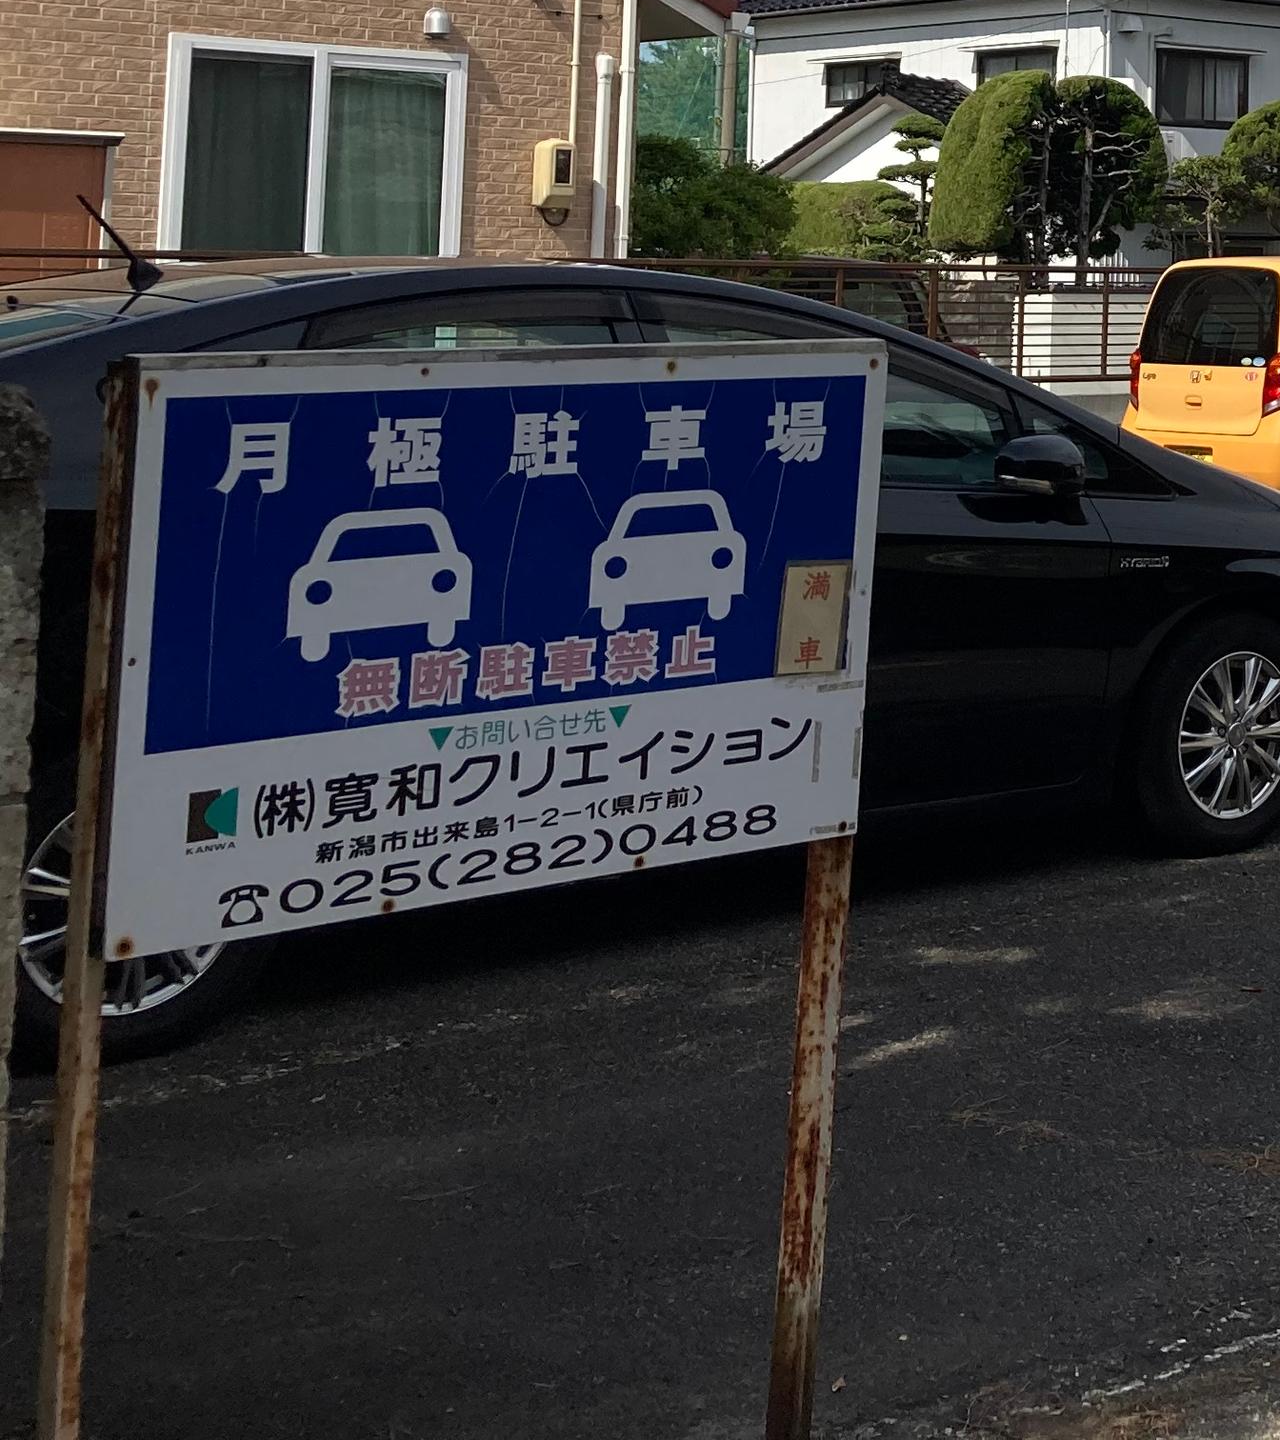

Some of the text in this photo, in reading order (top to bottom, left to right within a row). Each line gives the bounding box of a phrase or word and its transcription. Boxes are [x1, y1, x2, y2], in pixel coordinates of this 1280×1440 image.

[214, 400, 829, 495] 月極駐車場
[336, 624, 717, 718] 無断駐車禁止
[454, 709, 607, 751] お問い合せ先
[253, 717, 813, 839] (株)寛和クリエイション
[185, 841, 237, 856] KANWA
